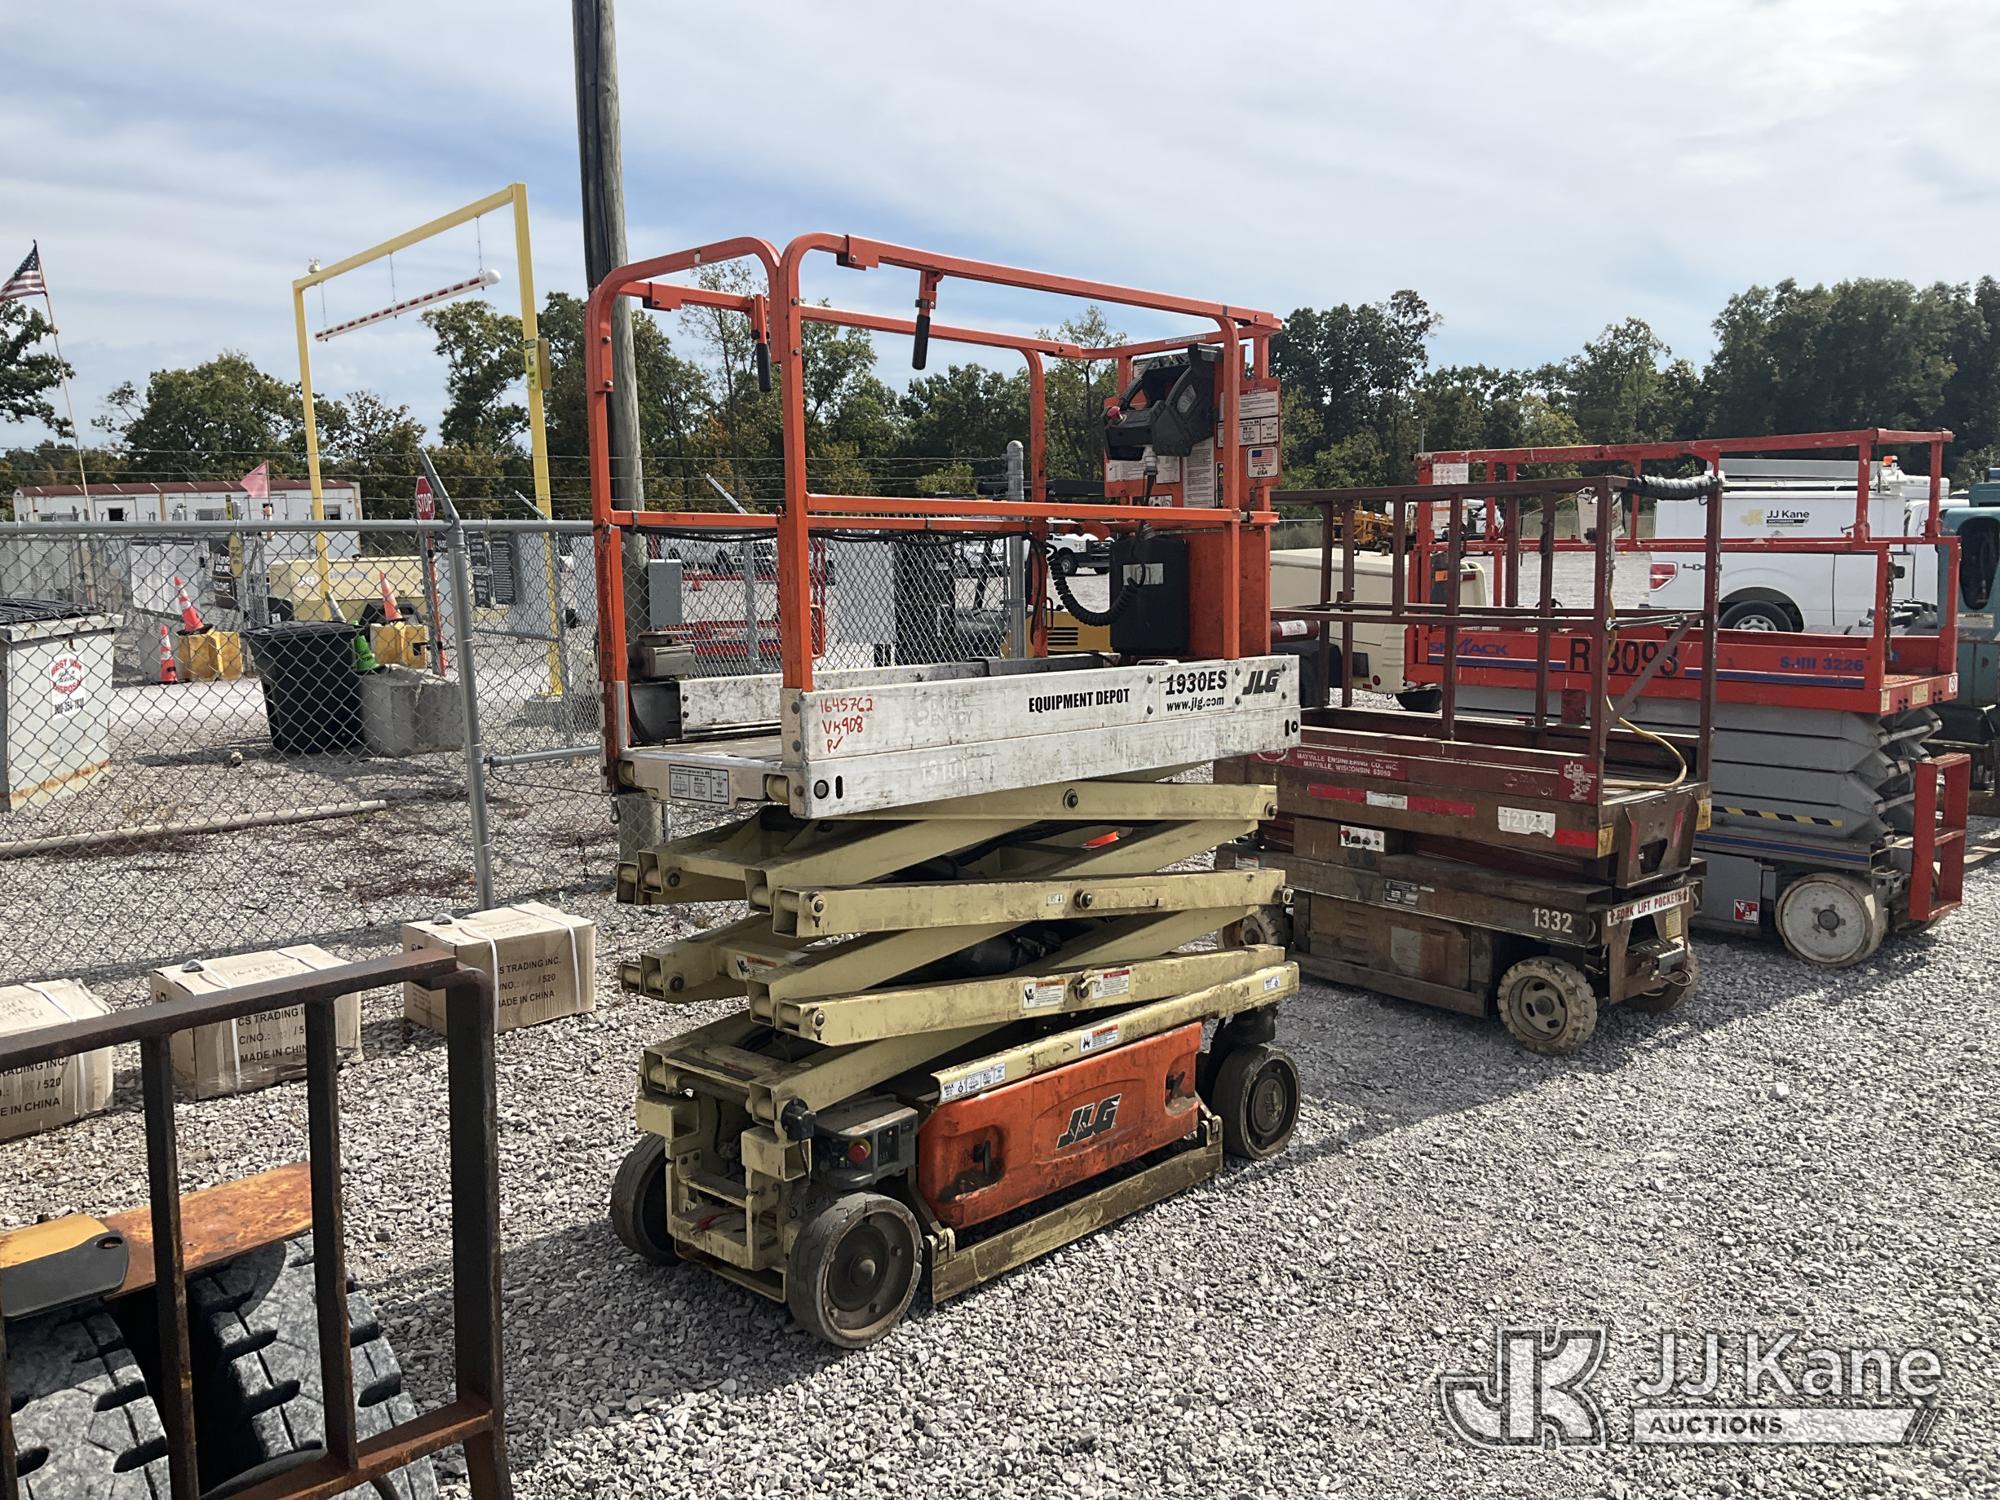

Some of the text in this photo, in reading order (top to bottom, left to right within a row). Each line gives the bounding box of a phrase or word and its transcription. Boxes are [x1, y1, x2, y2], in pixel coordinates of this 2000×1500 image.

[417, 493, 432, 512] STOP
[1782, 510, 1810, 518] Kane
[1823, 658, 1865, 672] 3226
[1166, 669, 1228, 696] 1930ES
[1242, 668, 1281, 696] JLG
[1028, 688, 1130, 713] EQUIPMENT DEPOT
[1166, 696, 1225, 712] www.jlg.com
[1637, 899, 1651, 914] LIFT
[1654, 890, 1683, 910] POCKETS
[1532, 907, 1573, 934] 1332
[506, 960, 544, 974] TRADING
[545, 956, 561, 967] INC.
[520, 995, 529, 1005] IN
[530, 990, 555, 1002] CHINA
[237, 1016, 251, 1027] CS
[254, 1006, 299, 1024] TRADING
[46, 1057, 68, 1070] INC.
[240, 1044, 307, 1064] MADE IN CHIN
[10, 1103, 22, 1116] IN
[24, 1097, 60, 1112] CHINA
[1056, 1092, 1122, 1150] JLG
